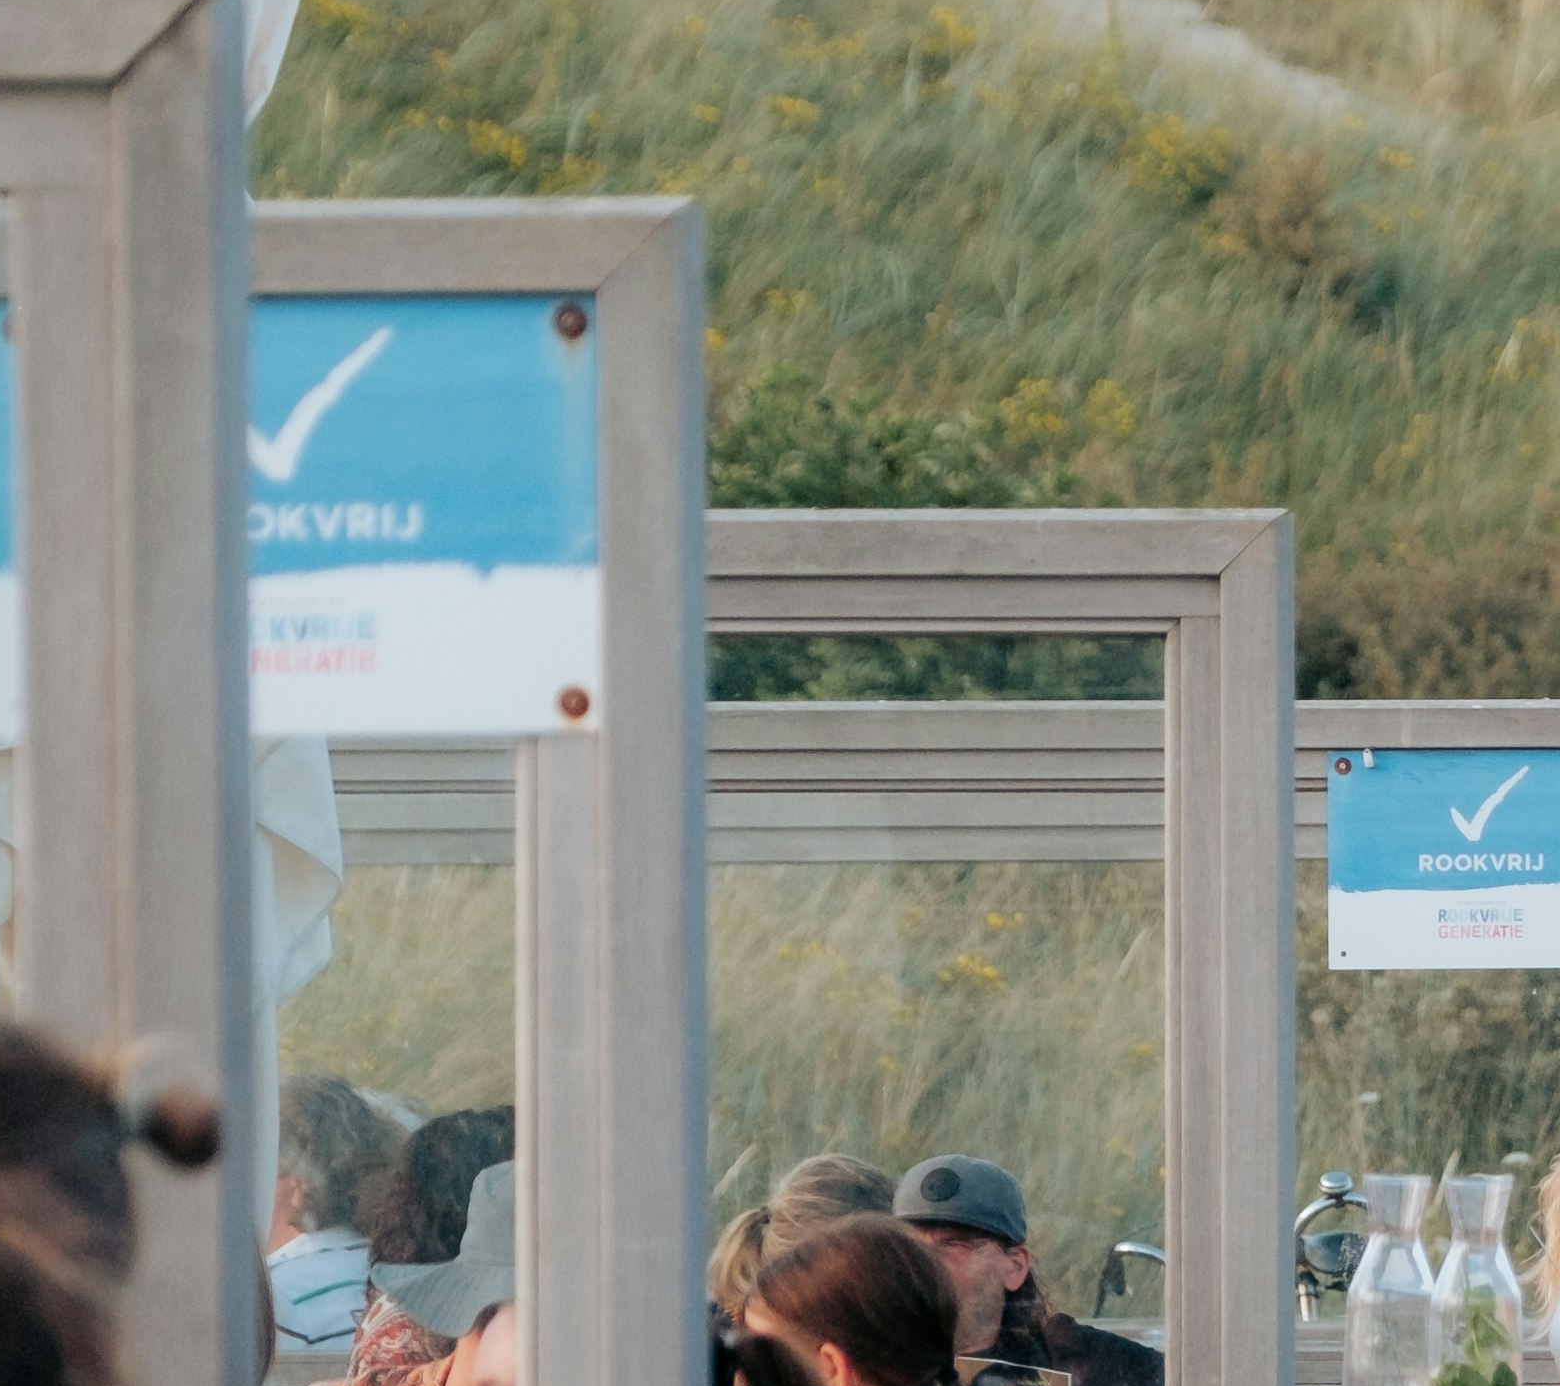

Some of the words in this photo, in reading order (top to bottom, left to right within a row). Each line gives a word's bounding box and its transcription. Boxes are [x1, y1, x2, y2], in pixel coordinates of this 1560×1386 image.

[1418, 853, 1544, 872] ROOKVRIJ
[1438, 909, 1523, 922] ROOKVRIJE
[1438, 925, 1524, 939] GENERATIE
